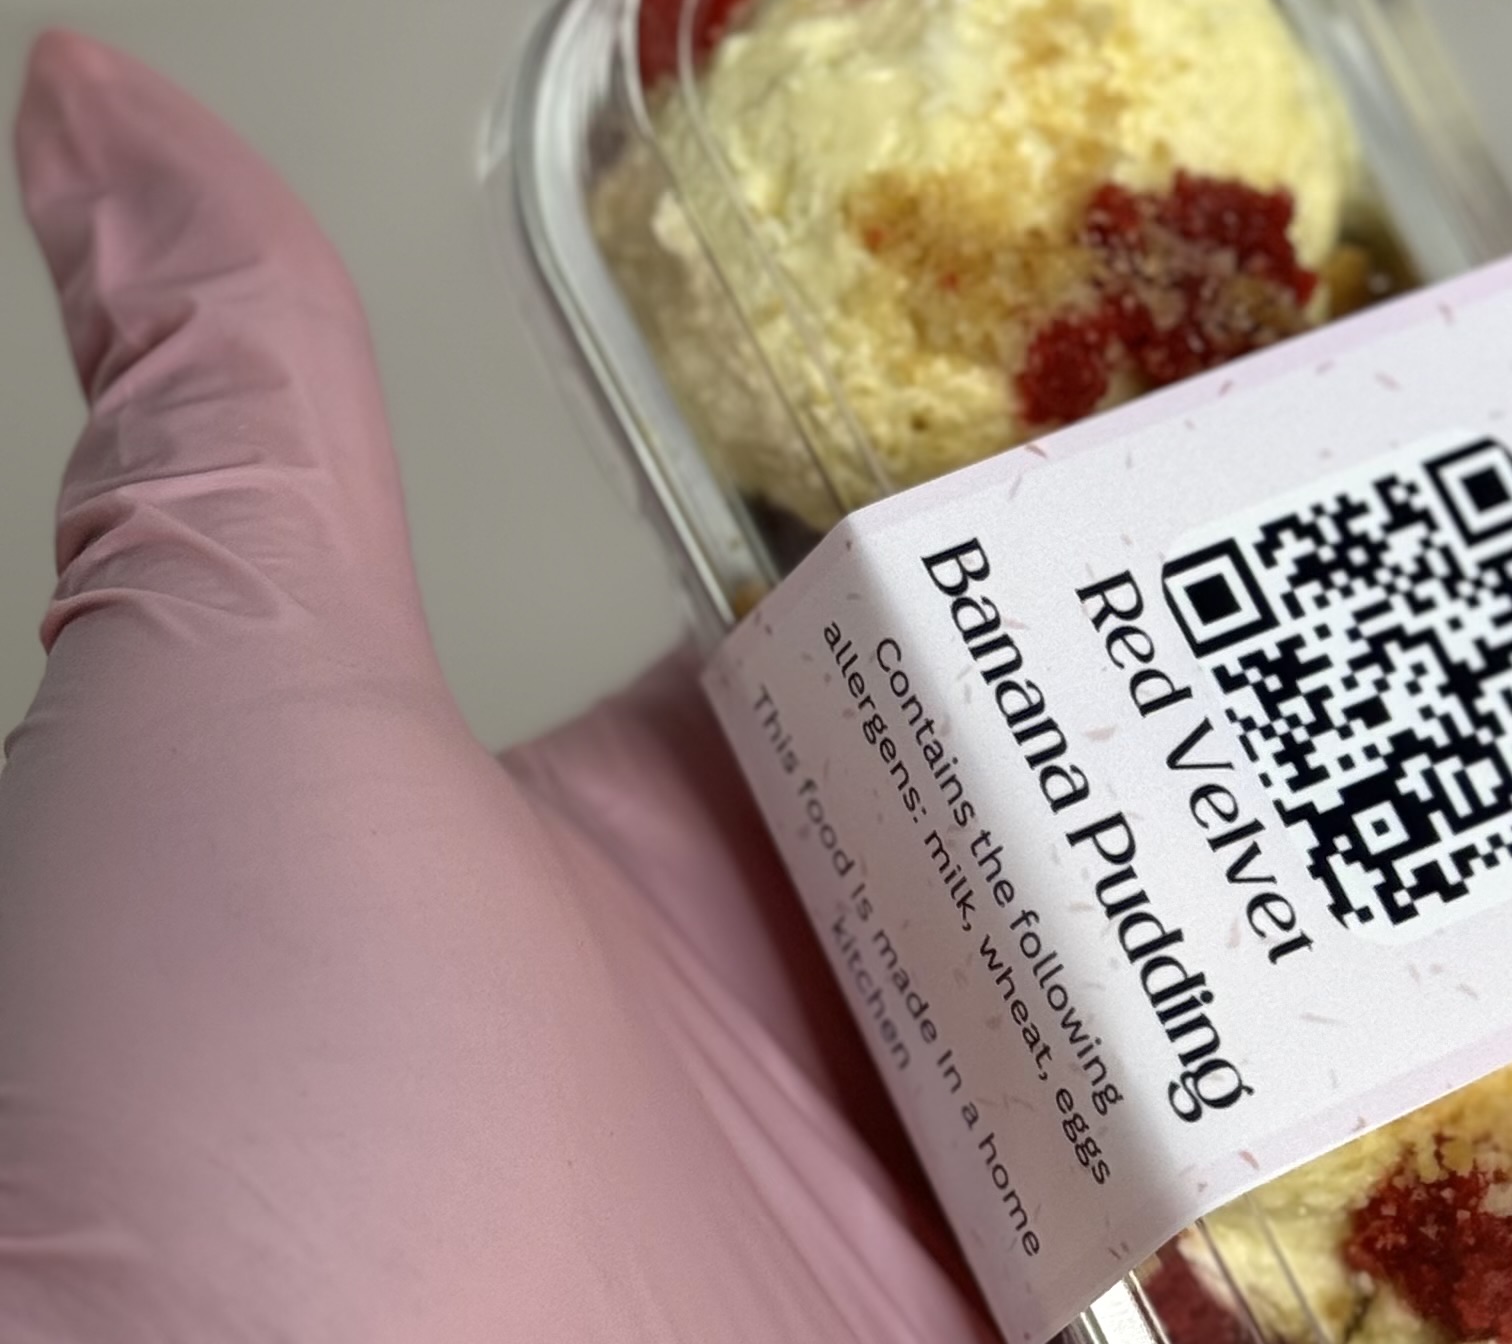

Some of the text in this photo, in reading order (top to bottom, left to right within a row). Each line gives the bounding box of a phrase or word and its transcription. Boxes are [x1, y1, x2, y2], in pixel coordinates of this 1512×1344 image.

[752, 685, 1041, 1258] This food is made in a home
[823, 620, 1111, 1186] allergens: milk, wheat, eggs
[831, 915, 912, 1071] kitchen
[875, 636, 1123, 1117] Contains the following
[920, 537, 1255, 1123] Banana Pudding
[1074, 569, 1314, 965] Red Velvet
